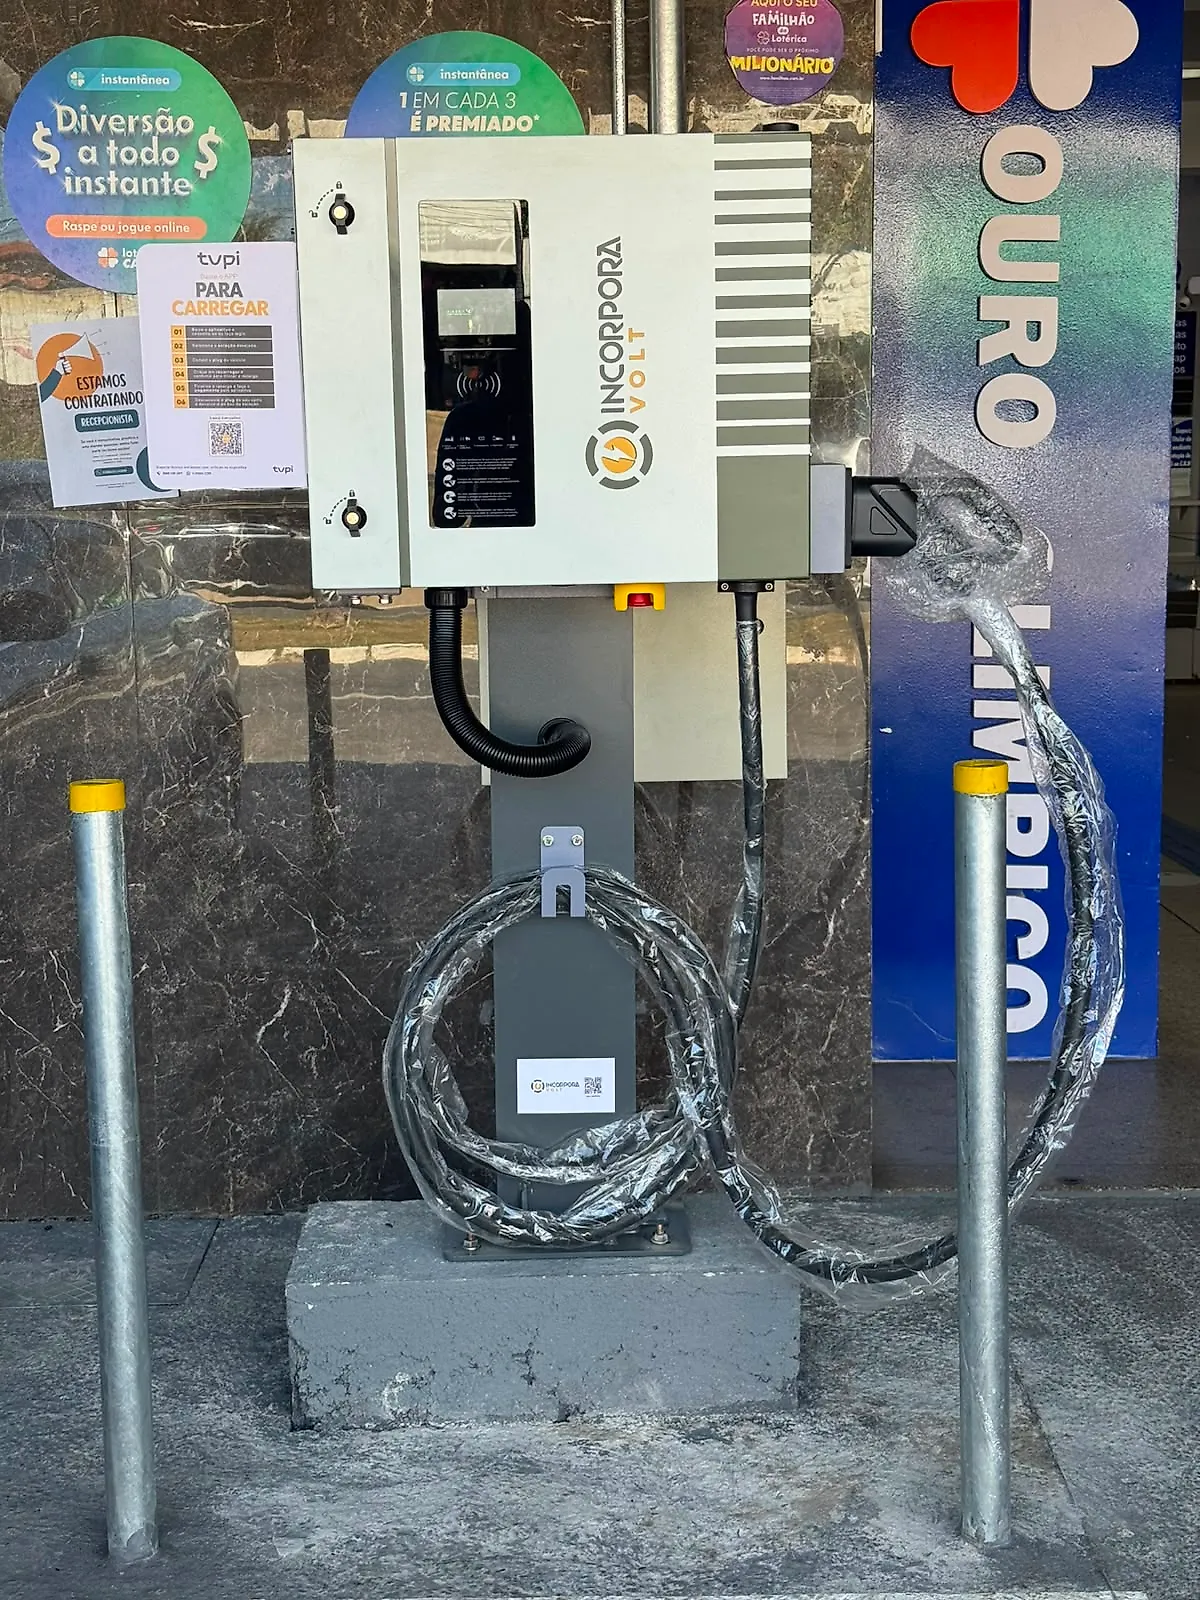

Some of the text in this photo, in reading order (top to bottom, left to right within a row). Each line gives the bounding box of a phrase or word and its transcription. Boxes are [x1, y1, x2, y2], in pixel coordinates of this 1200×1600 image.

[772, 34, 807, 43] Lotérica
[101, 73, 170, 86] instantânea
[439, 68, 509, 81] instantânea
[399, 92, 516, 109] 1 EM CADA 3
[56, 105, 195, 134] Diversão
[410, 110, 421, 132] É
[78, 136, 181, 167] a todo
[64, 167, 194, 196] instante
[63, 220, 190, 236] Raspe ou jogue online
[195, 282, 243, 298] PARA
[976, 124, 1064, 448] OURO
[171, 299, 269, 316] CARREGAR
[597, 236, 624, 414] INCORPORA
[628, 327, 646, 414] VOLT
[76, 373, 127, 391] ESTAMOS
[64, 391, 144, 410] CONTRATANDO
[80, 414, 134, 427] RECEPCIONISTA
